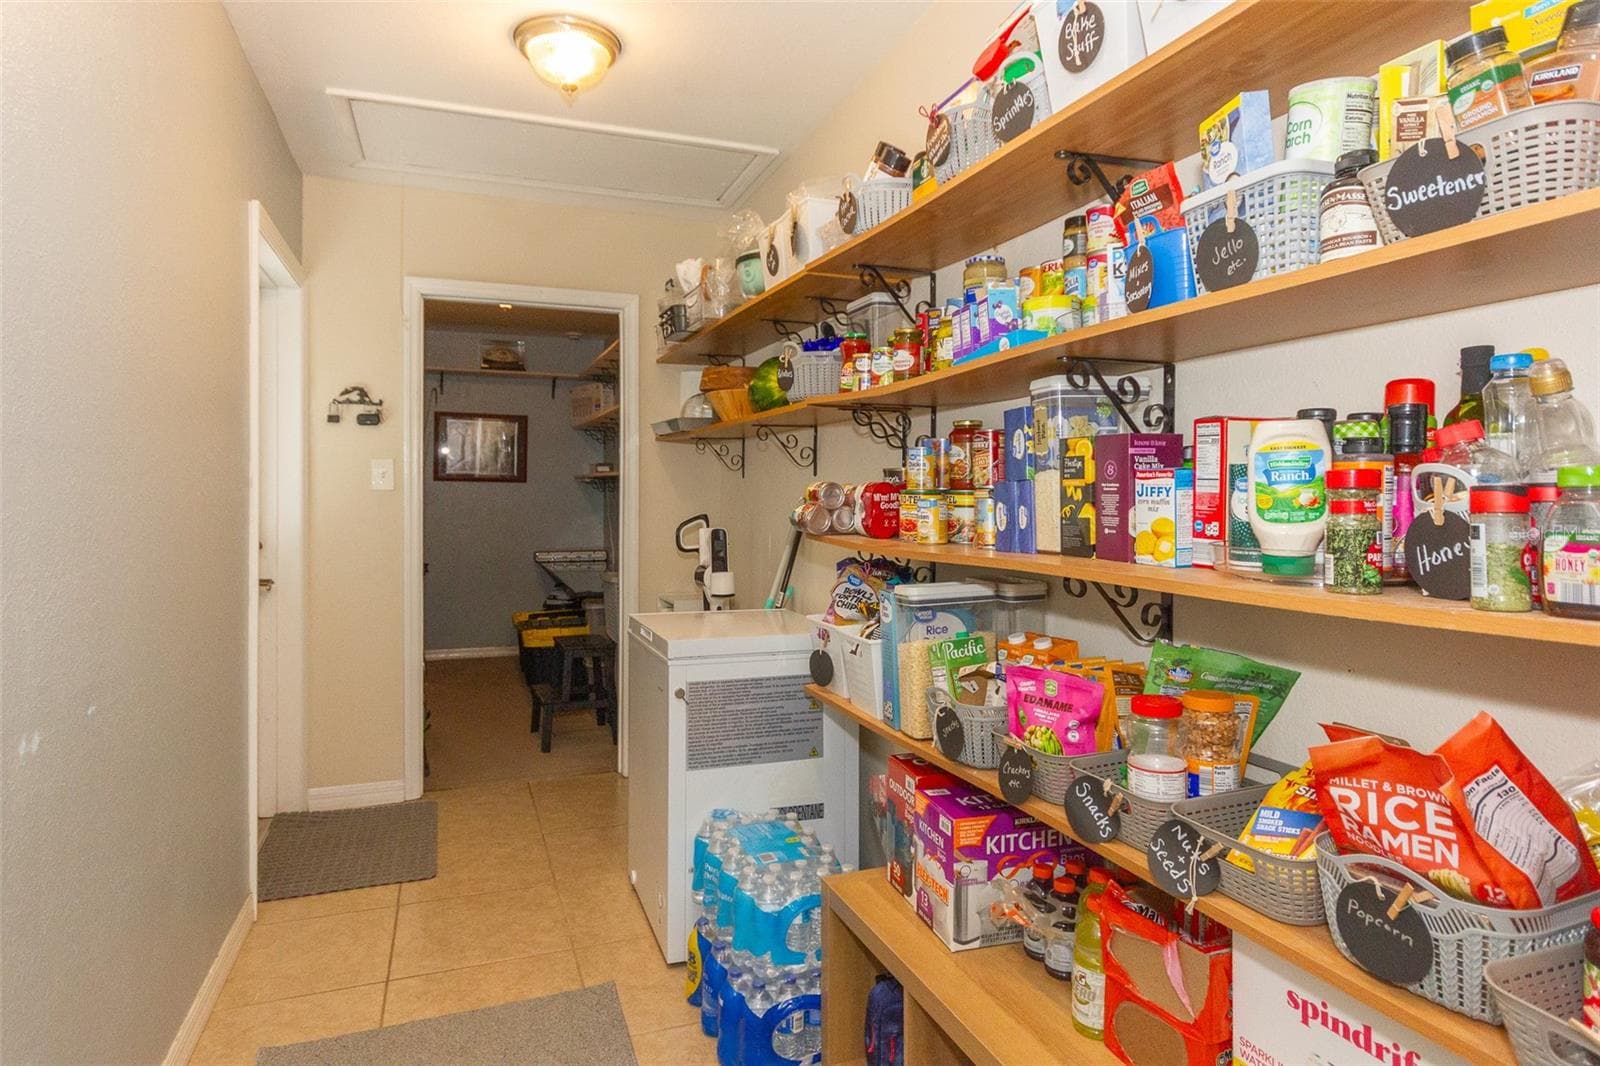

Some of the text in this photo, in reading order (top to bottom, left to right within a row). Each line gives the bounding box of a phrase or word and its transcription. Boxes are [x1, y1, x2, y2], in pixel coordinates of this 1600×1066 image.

[1066, 30, 1100, 61] Suff
[1534, 67, 1579, 82] KIRKLAND
[1130, 192, 1158, 210] ITALIAN
[1212, 239, 1244, 265] Jello
[1227, 258, 1247, 275] etc.
[1271, 470, 1309, 481] Ranch
[1137, 484, 1171, 498] JIFFY
[1555, 558, 1584, 572] HONEY
[926, 625, 948, 635] Rice
[943, 639, 985, 660] Pacific
[1024, 694, 1074, 713] EDAMAME
[1475, 768, 1500, 787] Facts
[1329, 776, 1450, 806] MILLET & BROWN
[1496, 786, 1516, 799] 130
[1075, 782, 1112, 838] Snacks
[1260, 809, 1280, 819] MILD
[1329, 786, 1457, 841] RICE
[986, 829, 1073, 855] KITCHEN
[1340, 813, 1460, 869] RAMEN
[1150, 838, 1191, 893] Seeds
[1347, 898, 1413, 948] Popcorn
